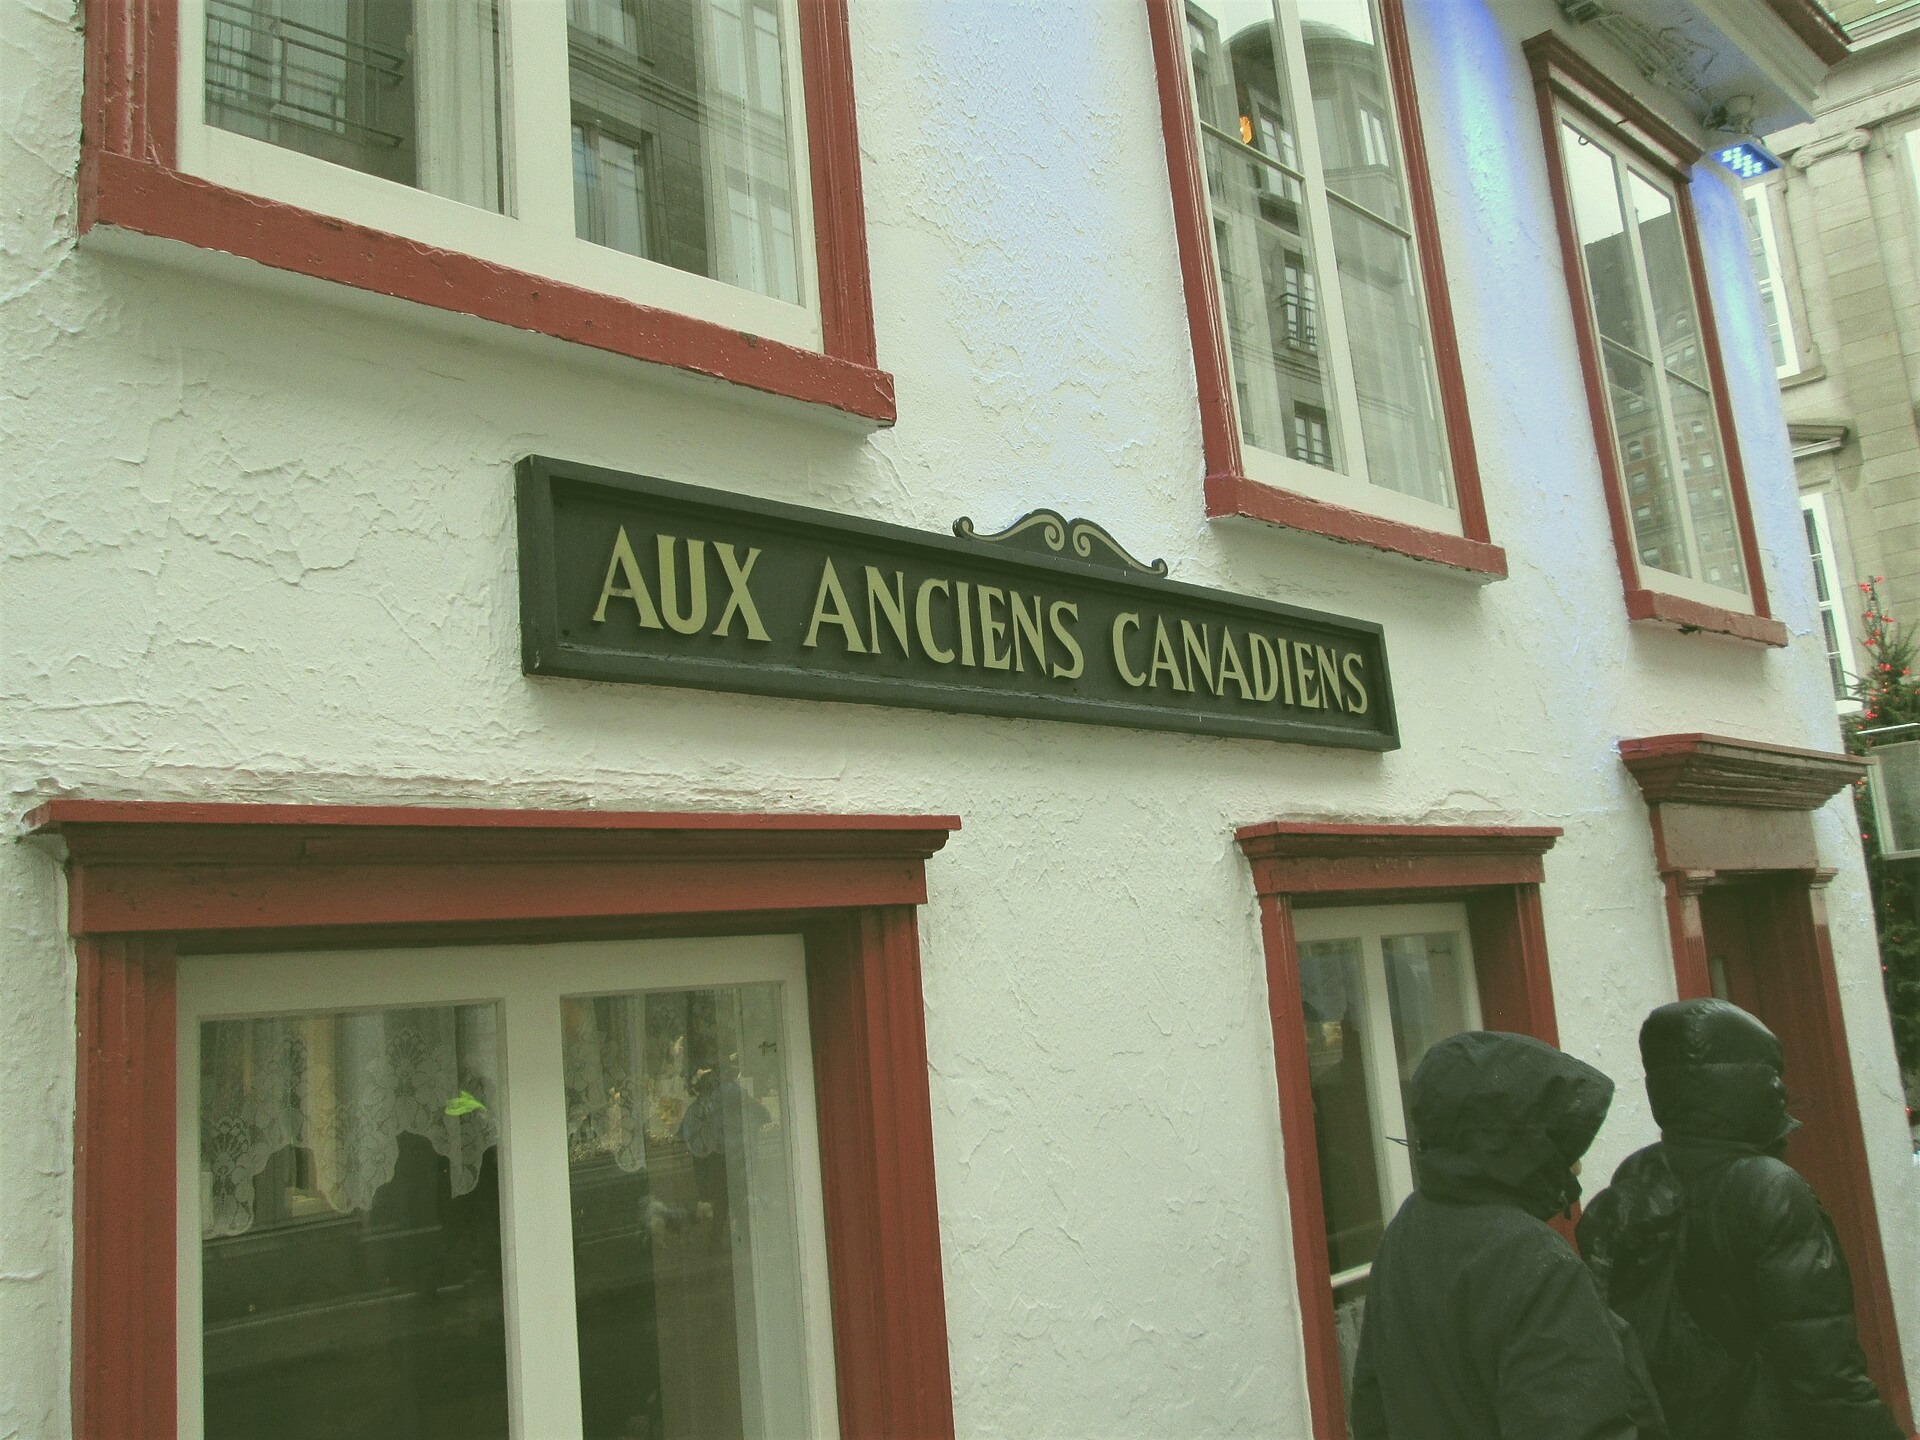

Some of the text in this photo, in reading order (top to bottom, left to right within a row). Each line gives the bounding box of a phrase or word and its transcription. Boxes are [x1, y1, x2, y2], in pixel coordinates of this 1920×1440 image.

[592, 525, 1368, 714] AUX ANCIENS CANADIENS
